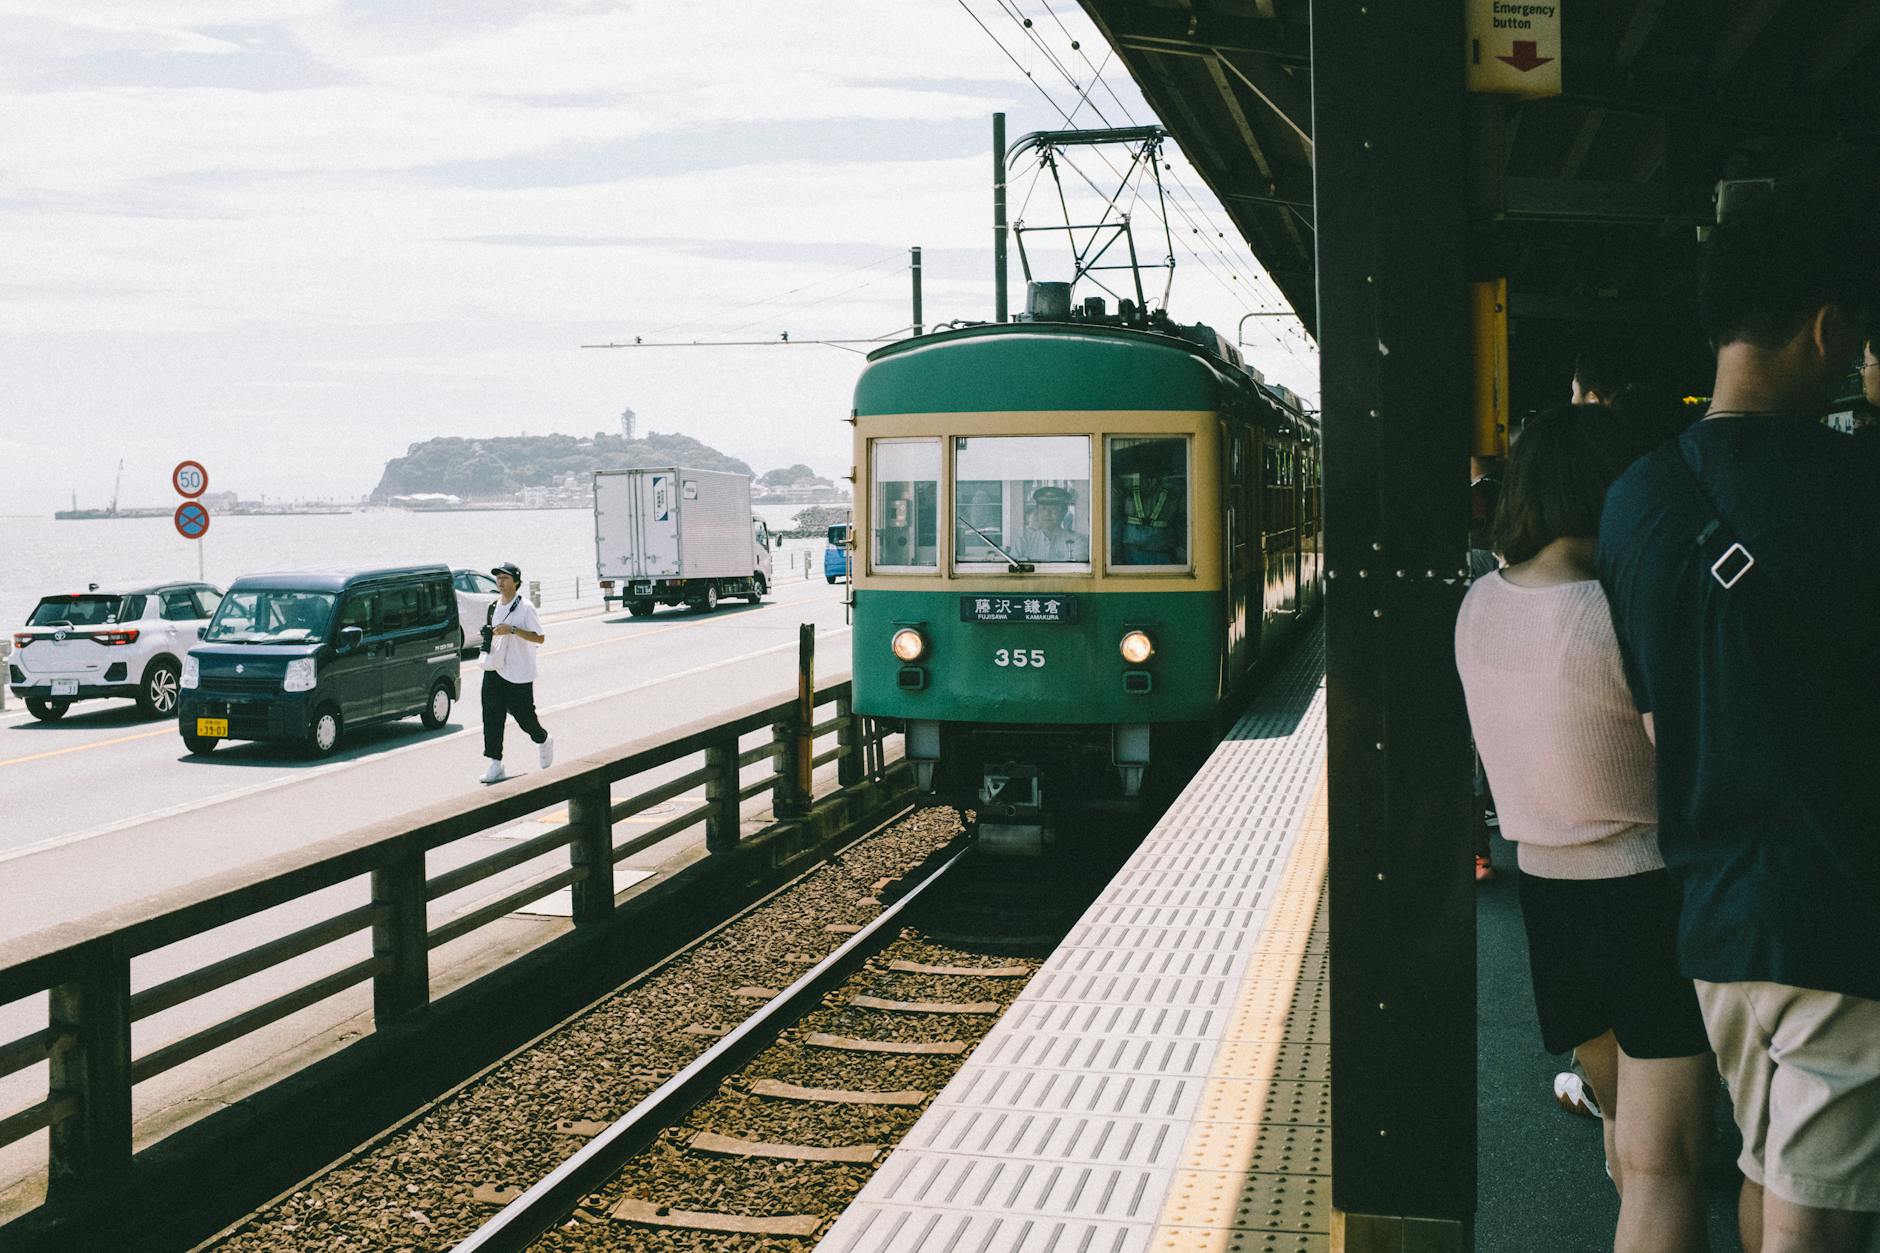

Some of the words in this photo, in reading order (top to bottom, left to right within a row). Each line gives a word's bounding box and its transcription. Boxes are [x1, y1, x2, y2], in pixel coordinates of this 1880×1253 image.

[1493, 1, 1555, 18] Emergency
[1493, 17, 1531, 29] button
[180, 471, 200, 488] 50
[994, 648, 1046, 668] 355
